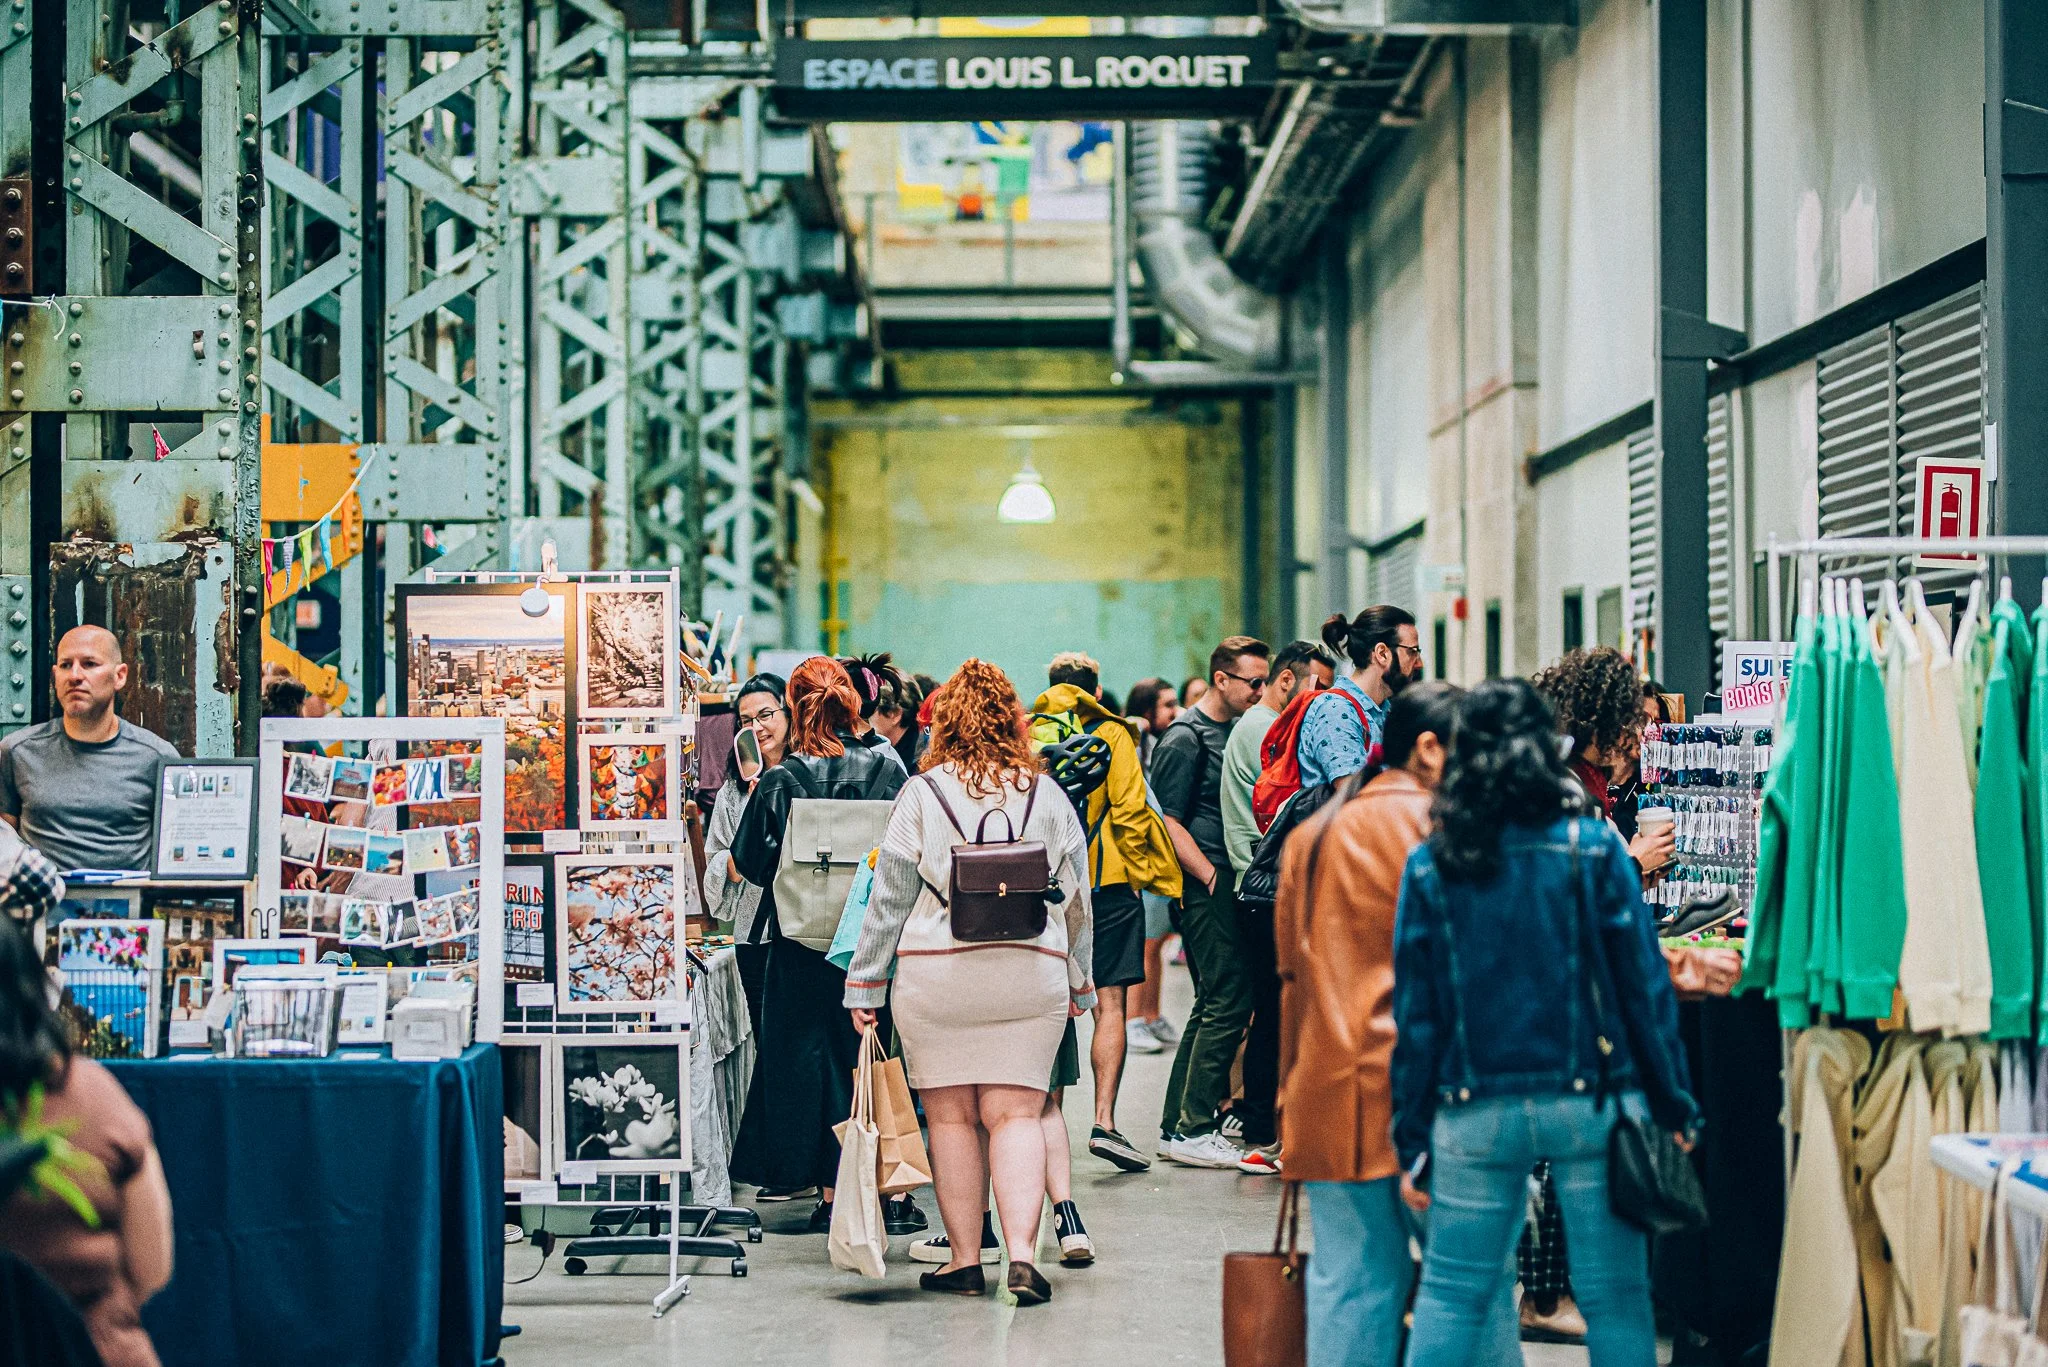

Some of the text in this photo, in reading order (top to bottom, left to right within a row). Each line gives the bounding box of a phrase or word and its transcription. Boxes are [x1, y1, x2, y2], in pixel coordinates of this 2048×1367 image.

[804, 58, 938, 89] ESPACE
[946, 57, 1052, 88] LOUIS
[1096, 55, 1250, 88] ROQUET
